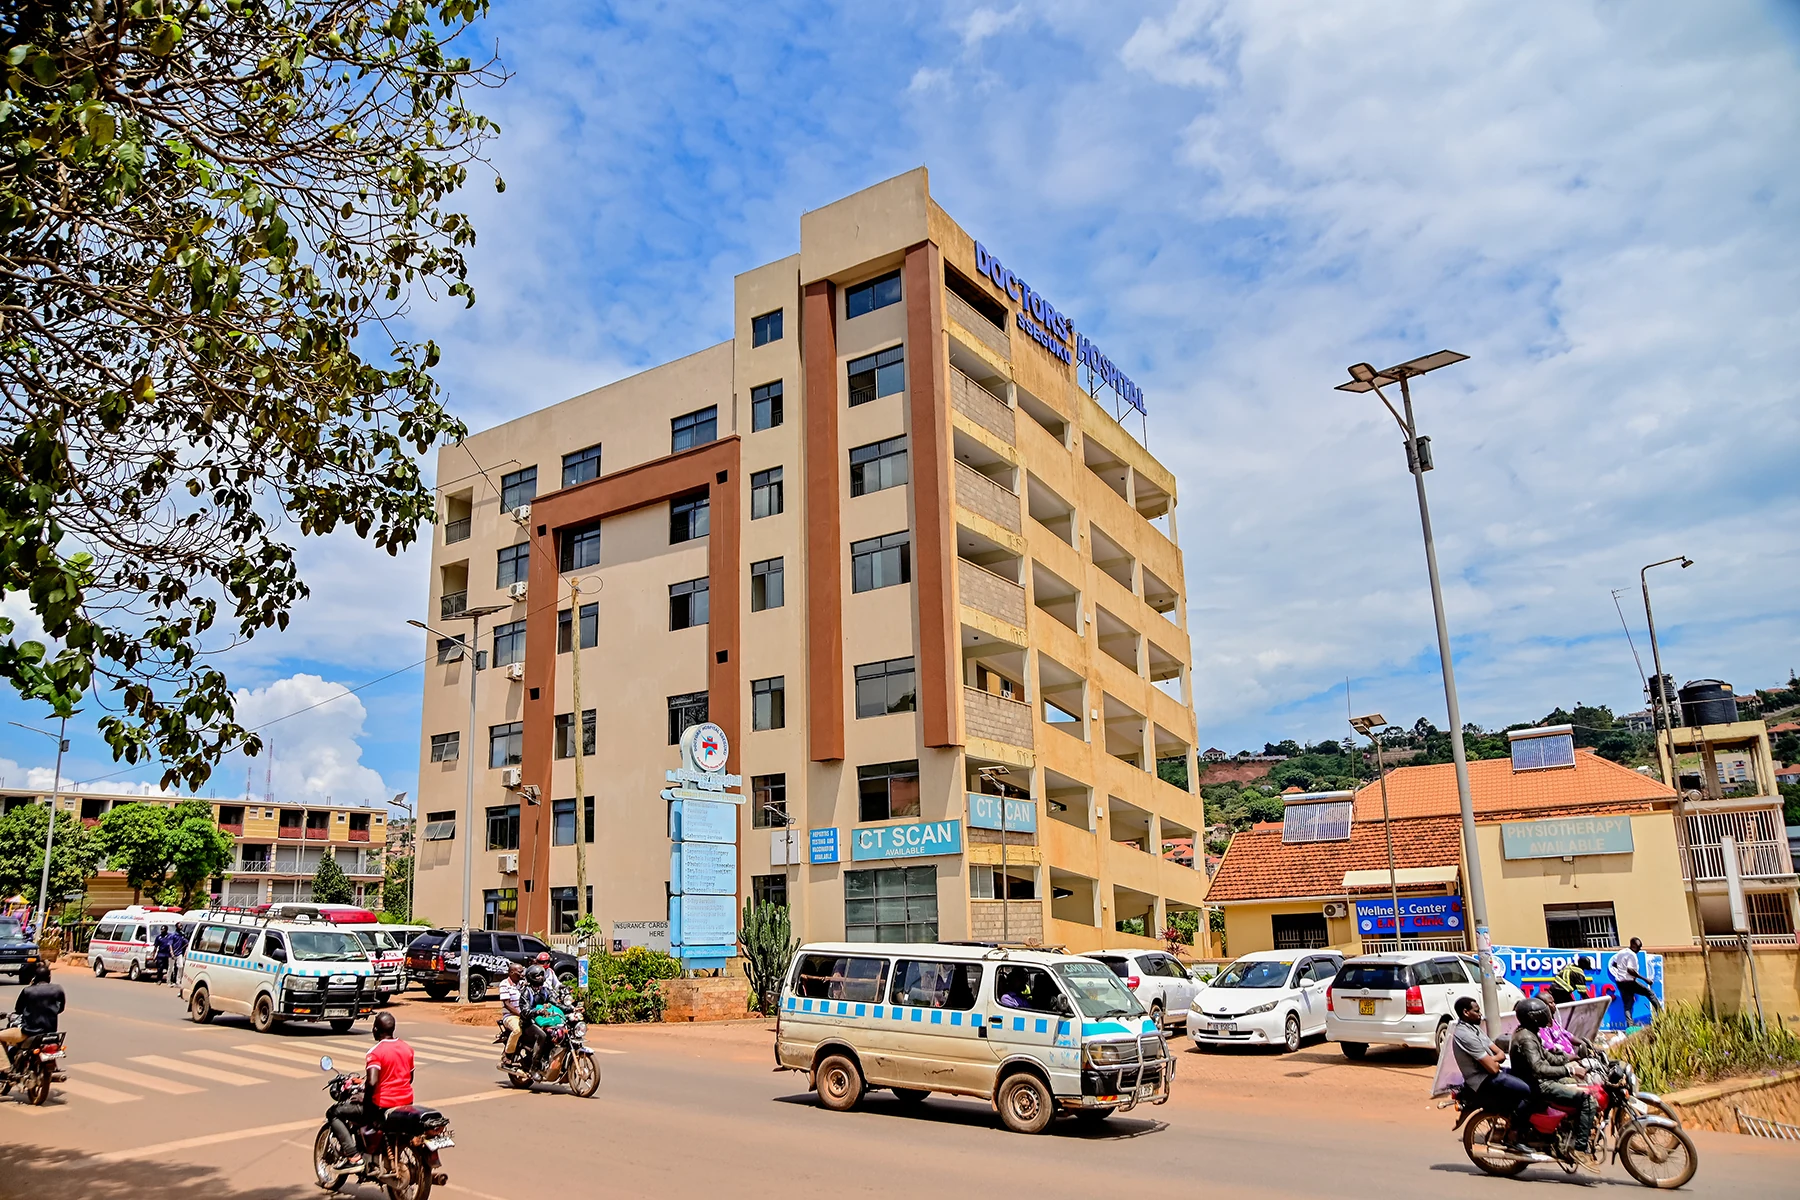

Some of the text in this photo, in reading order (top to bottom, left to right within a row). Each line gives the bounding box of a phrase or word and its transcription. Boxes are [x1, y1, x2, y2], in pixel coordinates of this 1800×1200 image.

[1016, 312, 1072, 366] SSEGUKU
[1076, 332, 1148, 416] HOSPITAL
[976, 797, 1030, 822] CT SCAN
[859, 823, 952, 849] CT SCAN
[1507, 819, 1624, 839] PHYSIOTHERAPY
[885, 846, 925, 856] AVAILABLE
[1529, 838, 1606, 854] AVAILABLE
[1357, 905, 1405, 916] Wellnes
[1409, 904, 1446, 914] Center
[1413, 915, 1444, 926] Clinic
